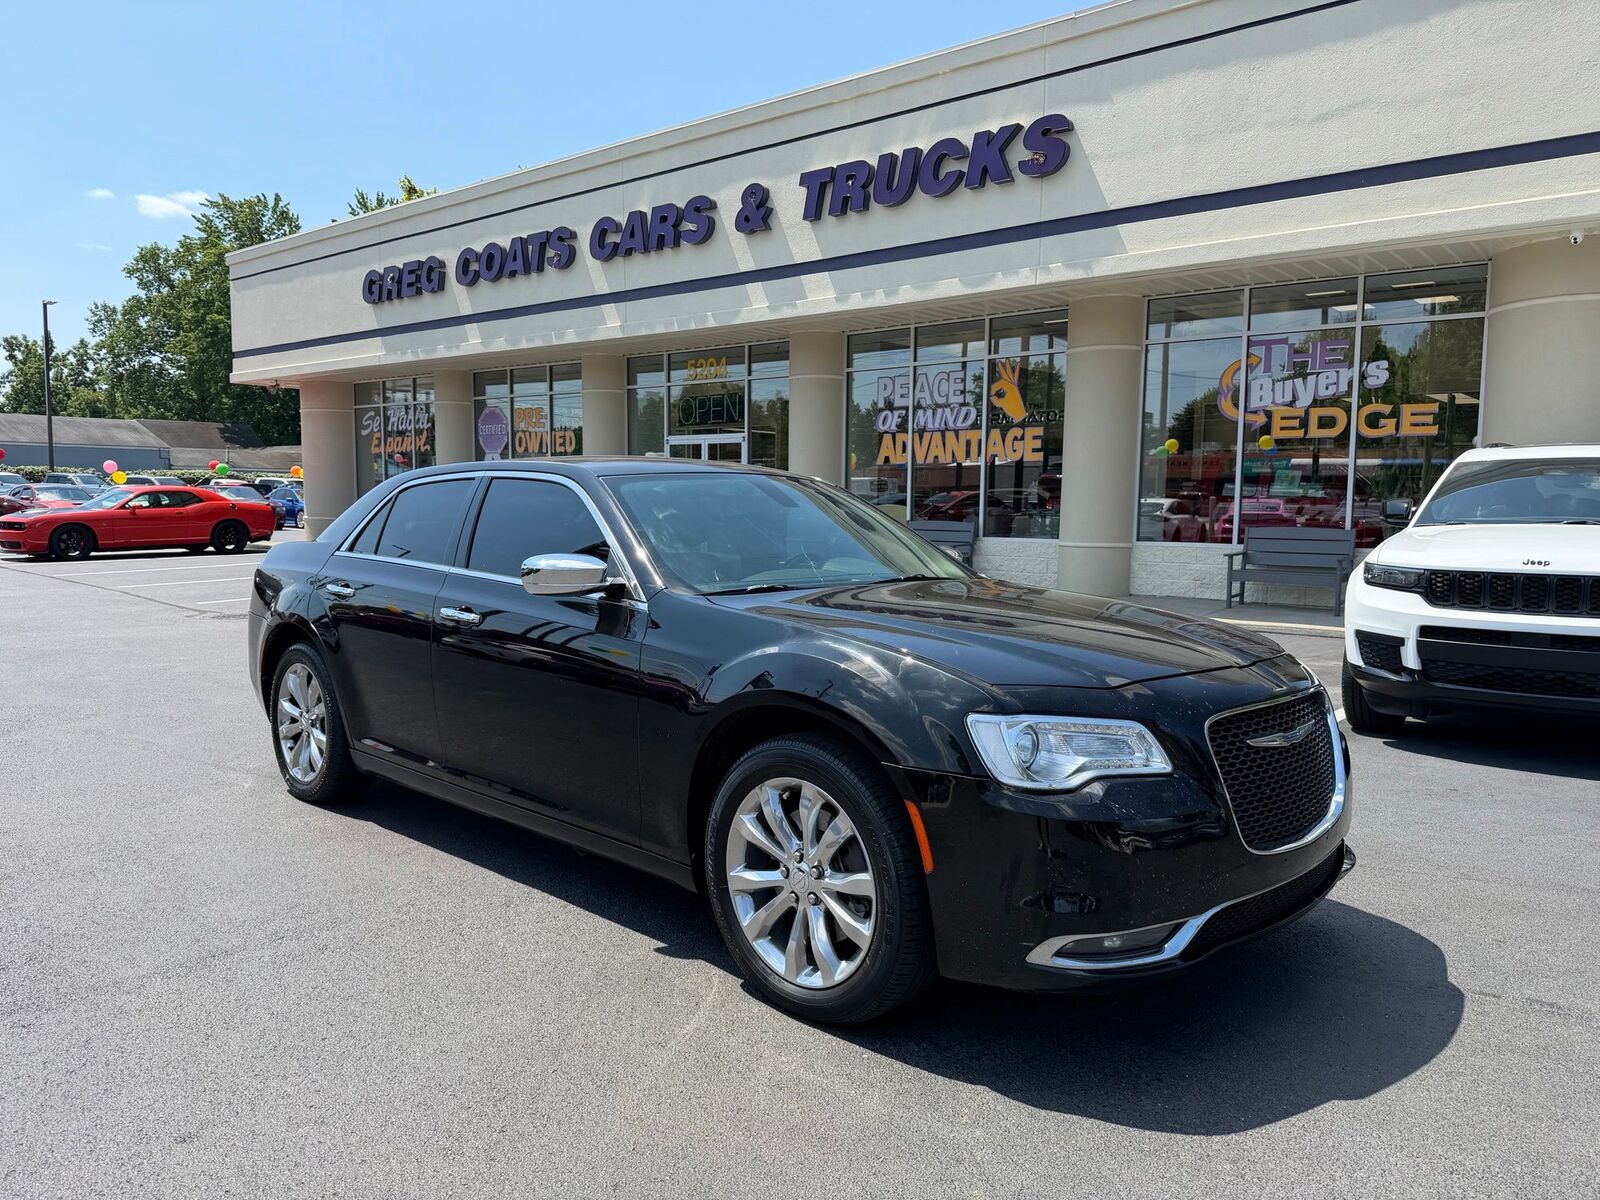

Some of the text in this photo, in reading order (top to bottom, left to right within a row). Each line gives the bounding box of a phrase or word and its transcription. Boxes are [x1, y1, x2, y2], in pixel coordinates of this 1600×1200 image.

[362, 113, 1075, 305] GREG COATS CARS & TRUCKS
[687, 356, 729, 381] 5204
[1249, 337, 1350, 374] THE
[876, 369, 967, 408] PEACE
[1247, 359, 1390, 410] Buyer's
[361, 404, 432, 435] Se Habla
[514, 406, 549, 429] PRE-
[679, 393, 740, 425] OPEN
[875, 404, 977, 433] OF MIND
[1270, 401, 1441, 439] EDGE
[371, 430, 432, 455] Epañl
[479, 423, 507, 435] CERTIFIED
[514, 431, 577, 454] OWNED
[876, 426, 1044, 466] ADVANTAGE
[1522, 558, 1551, 567] Jeep
